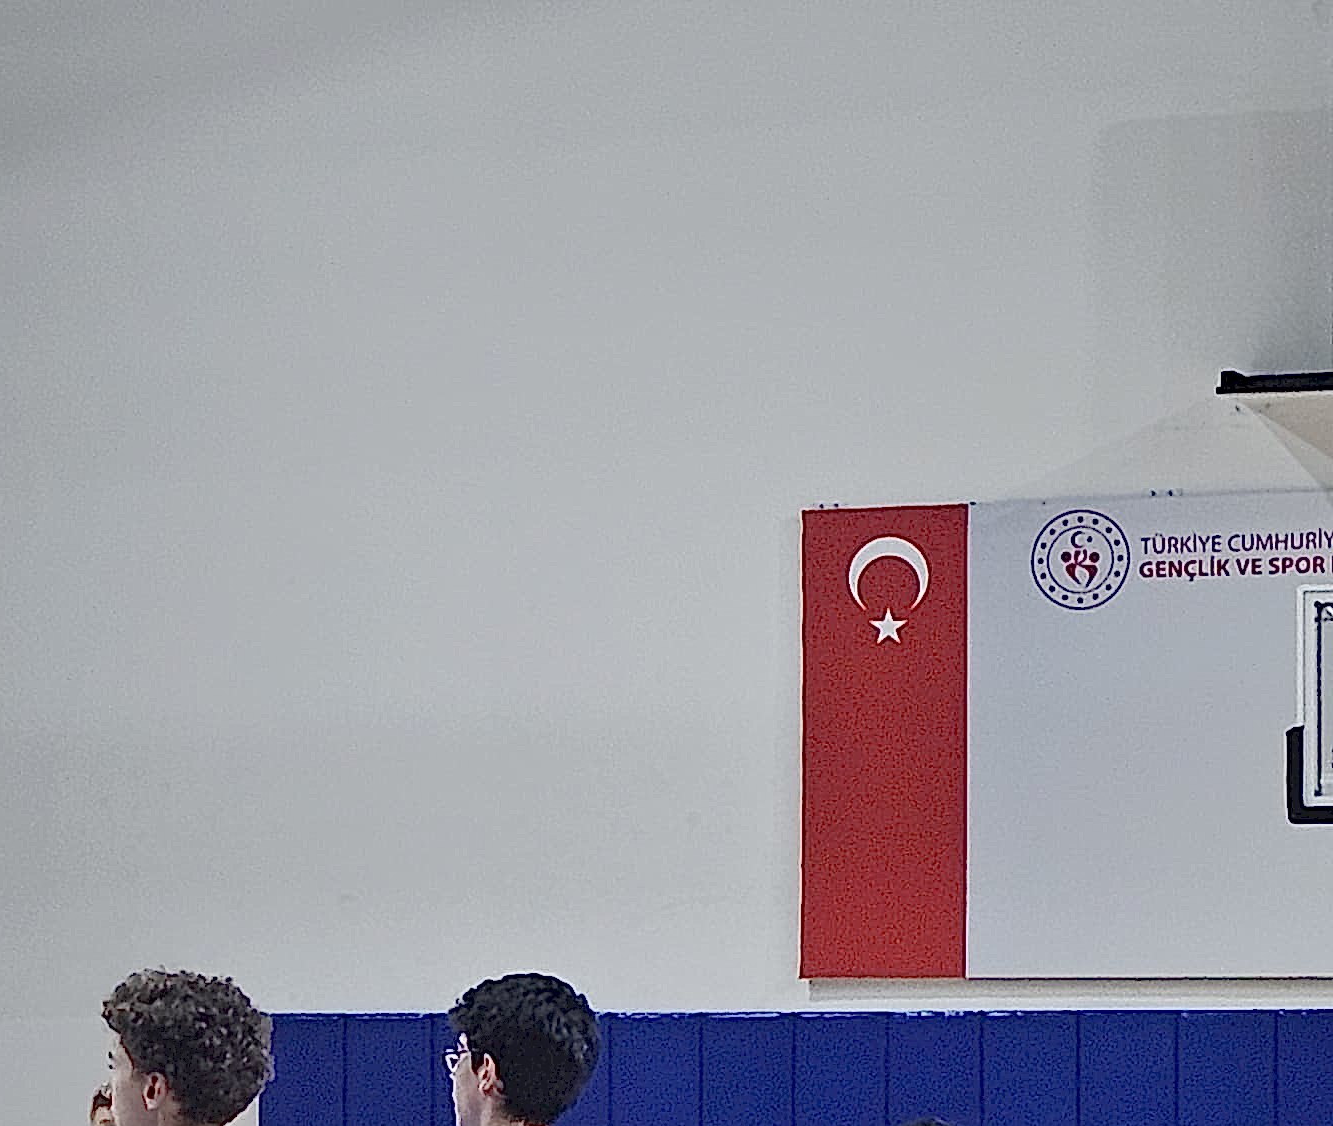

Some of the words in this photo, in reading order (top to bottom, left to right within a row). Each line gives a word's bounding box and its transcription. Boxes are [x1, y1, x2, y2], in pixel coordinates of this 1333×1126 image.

[1140, 533, 1222, 555] TÜRKİYE
[1139, 556, 1230, 582] GENÇLİK
[1236, 558, 1263, 576] VE
[1268, 555, 1325, 575] SPOR
